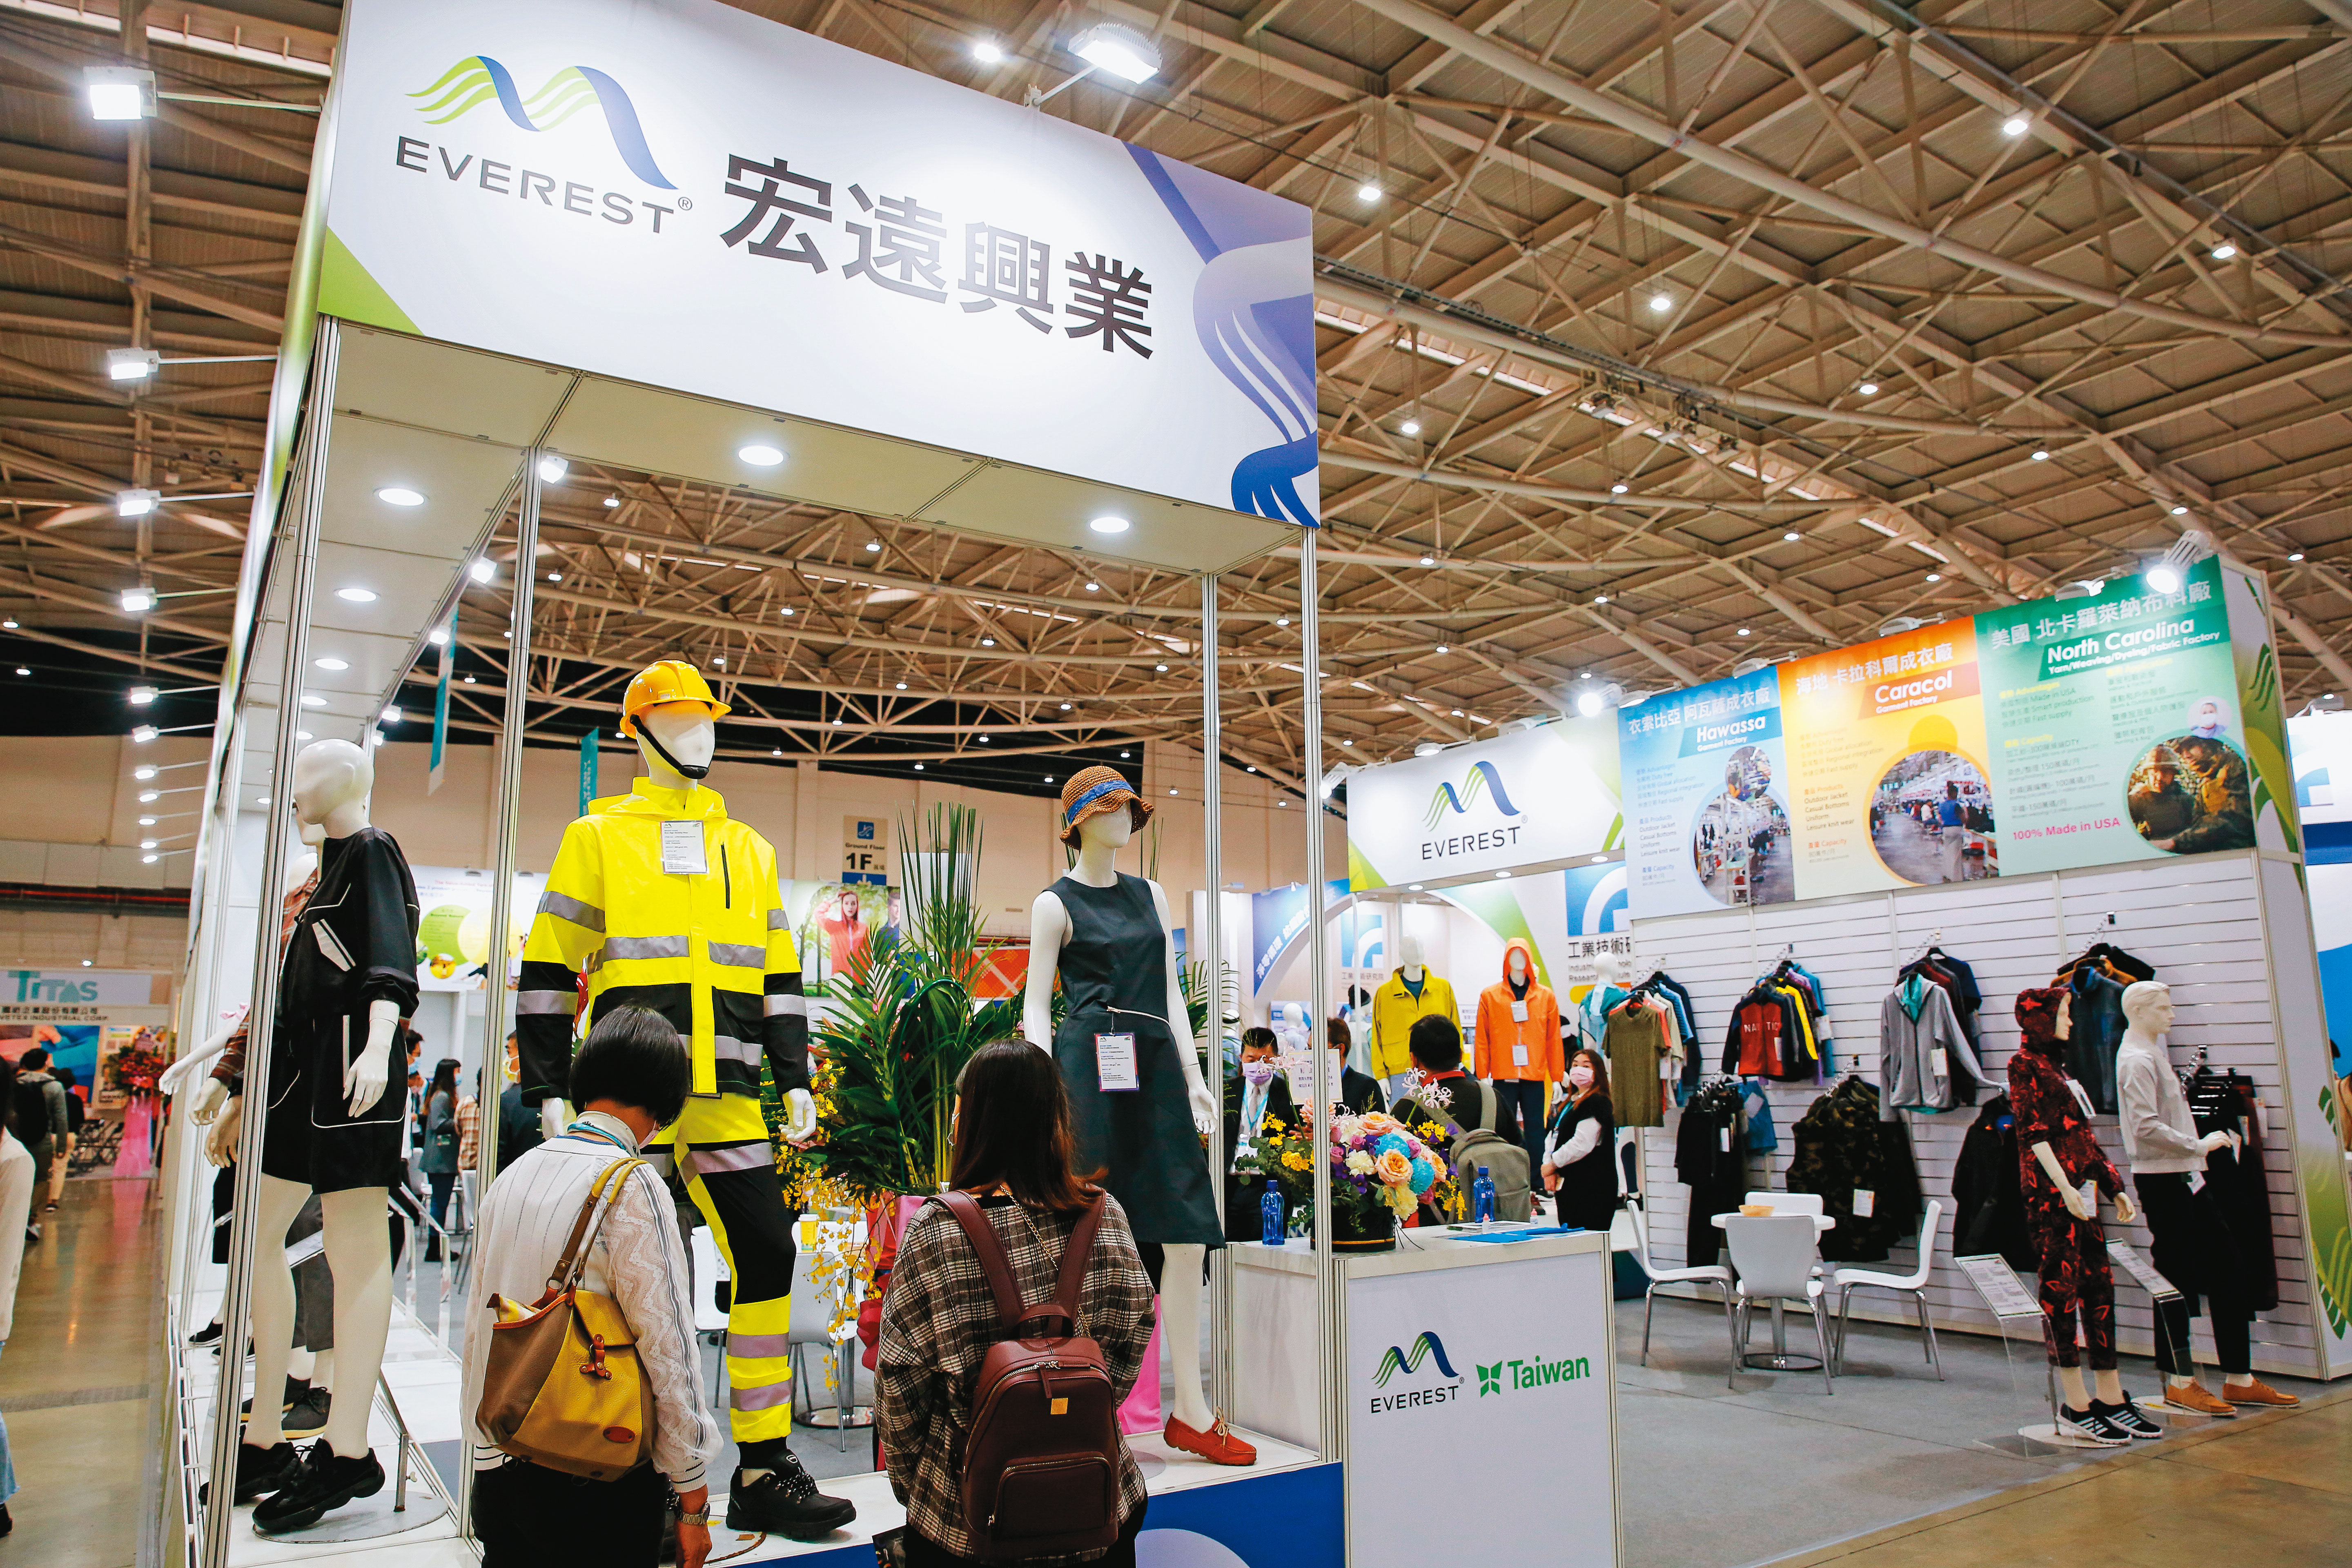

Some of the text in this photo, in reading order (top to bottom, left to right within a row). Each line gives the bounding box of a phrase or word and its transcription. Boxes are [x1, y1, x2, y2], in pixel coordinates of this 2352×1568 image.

[397, 136, 675, 234] EVEREST
[722, 154, 1154, 359] 宏遠興業
[1992, 581, 2212, 650] 美國 北卡羅萊納布料廠
[2048, 619, 2195, 664] North Carolina
[2183, 631, 2220, 646] Factory
[1796, 642, 1953, 695] 海地 卡拉科爾成衣廠
[1875, 669, 1952, 703] Caracol
[1628, 687, 1771, 734] 衣索比亞 阿瓦薩成衣廠
[1875, 695, 1938, 714] Garment Factory
[1697, 716, 1766, 743] Hawassa
[1724, 736, 1748, 747] Factory
[1422, 826, 1521, 860] EVEREST
[2013, 817, 2120, 840] 100% Made in USA
[846, 852, 872, 870] 1F
[1507, 1356, 1590, 1390] Taiwan
[1370, 1386, 1459, 1414] EVEREST
